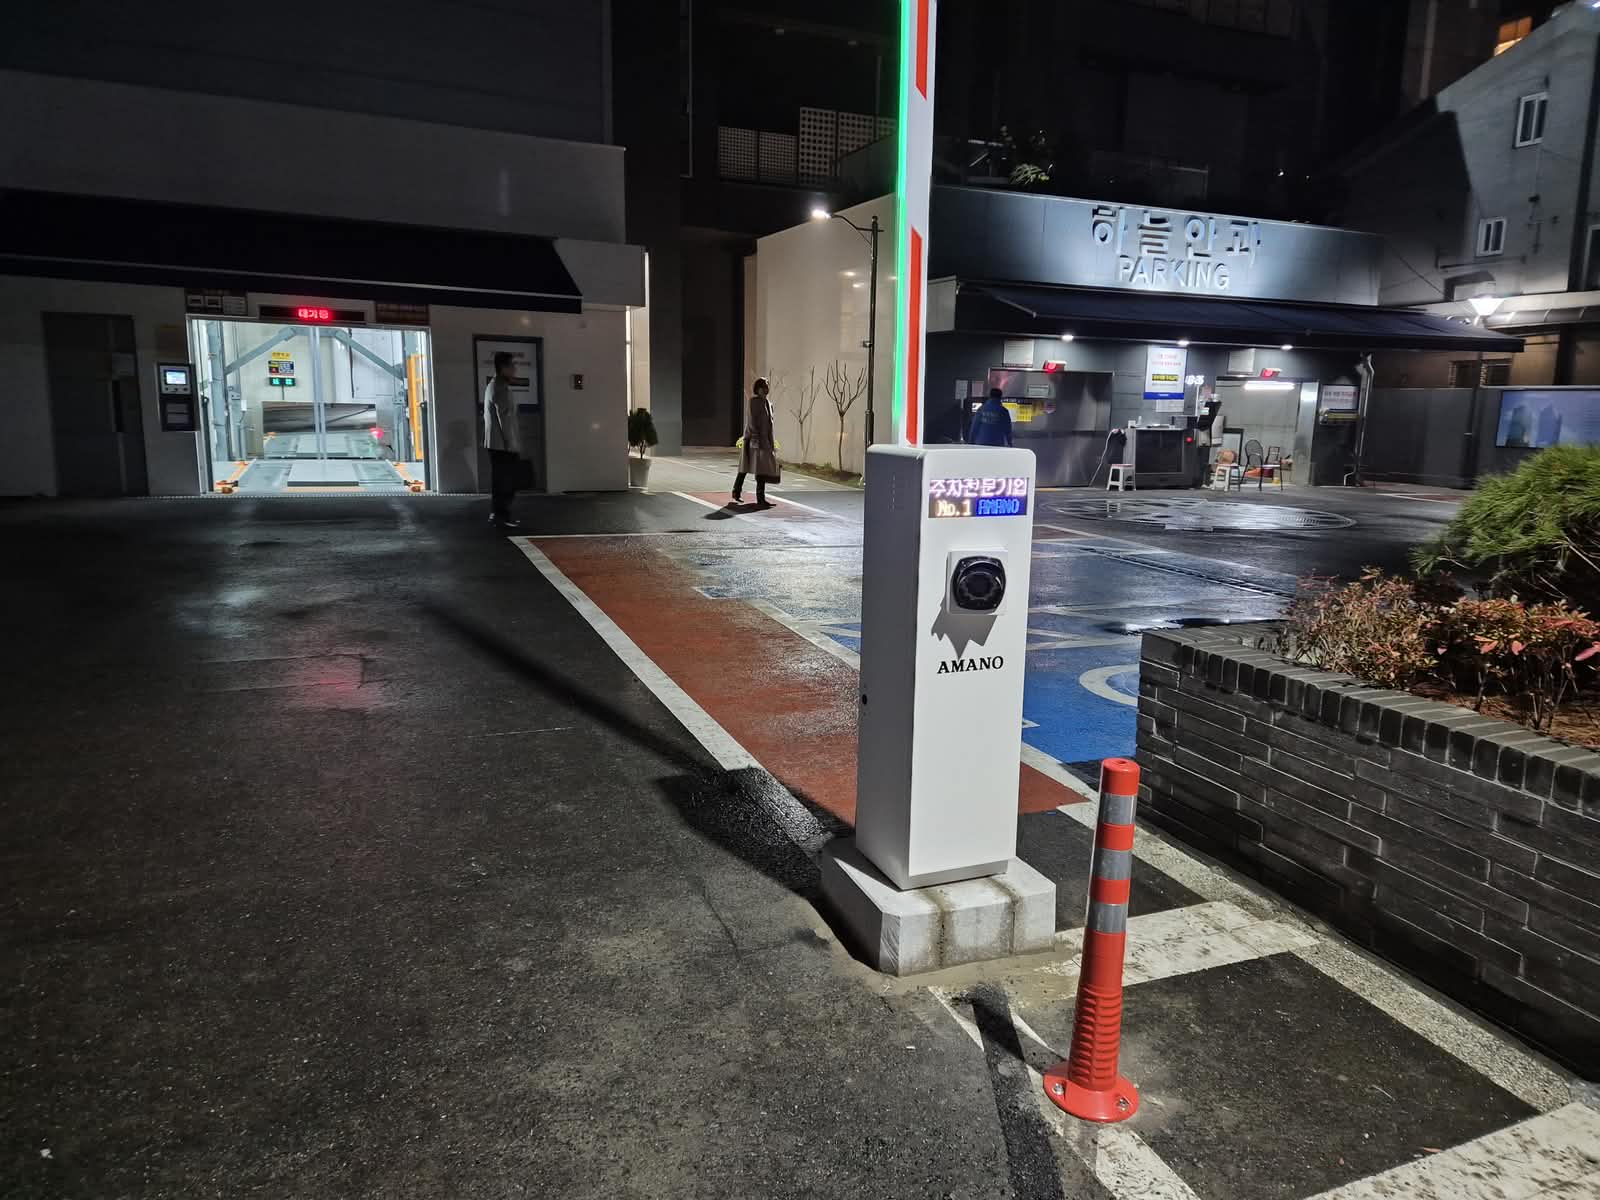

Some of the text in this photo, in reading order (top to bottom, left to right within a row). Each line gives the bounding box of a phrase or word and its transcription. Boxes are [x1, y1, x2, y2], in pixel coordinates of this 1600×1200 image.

[1091, 204, 1262, 268] 하늘안과
[1117, 255, 1230, 290] PARKING
[928, 479, 1028, 497] 주차전문기업
[936, 497, 1020, 516] No.1 AMANO
[936, 655, 1004, 674] AMANO
